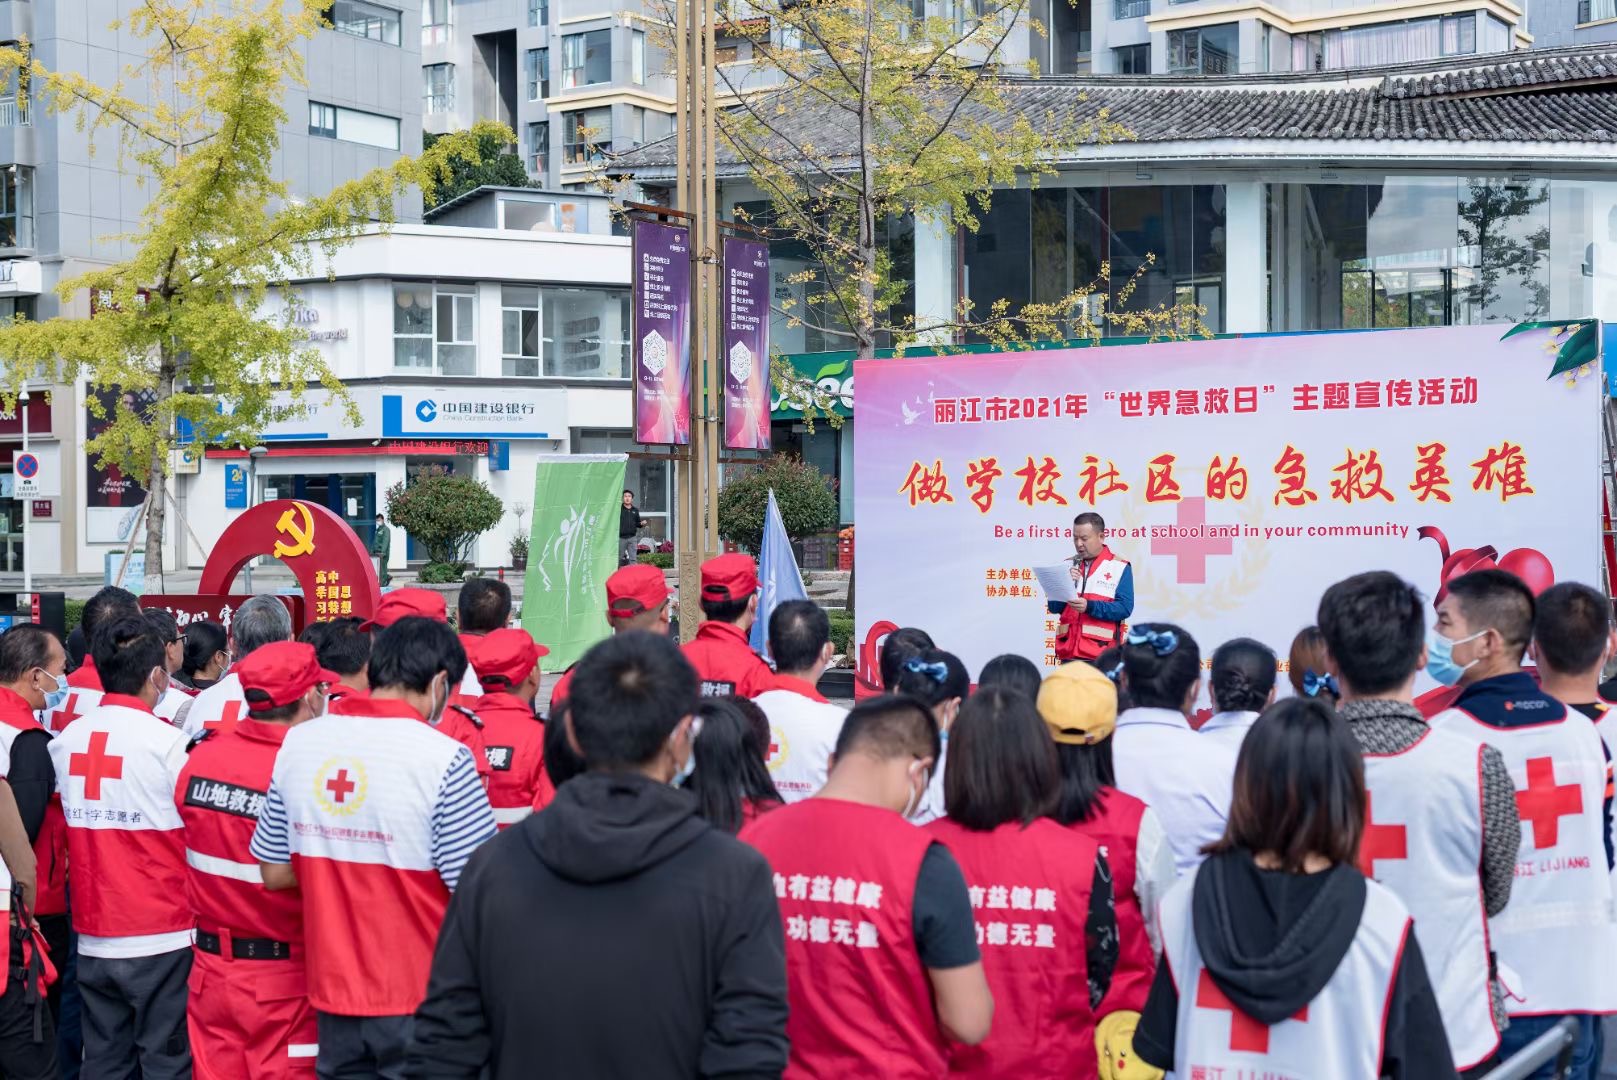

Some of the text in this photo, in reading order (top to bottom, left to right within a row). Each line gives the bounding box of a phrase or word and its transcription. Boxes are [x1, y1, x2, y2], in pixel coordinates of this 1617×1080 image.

[442, 402, 536, 415] 中国建设银行
[899, 441, 1535, 514] 做学校社区的急救英雄
[994, 525, 1013, 538] Be
[1017, 528, 1024, 538] a
[1029, 525, 1060, 538] first
[1104, 528, 1127, 538] ero
[1131, 527, 1146, 538] at
[1151, 524, 1204, 538] school
[1208, 524, 1239, 538] and
[1244, 524, 1259, 537] in
[1264, 526, 1303, 539] your
[1307, 522, 1409, 539] community
[1540, 856, 1591, 873] LIJIANG
[786, 913, 880, 948] 功德无量
